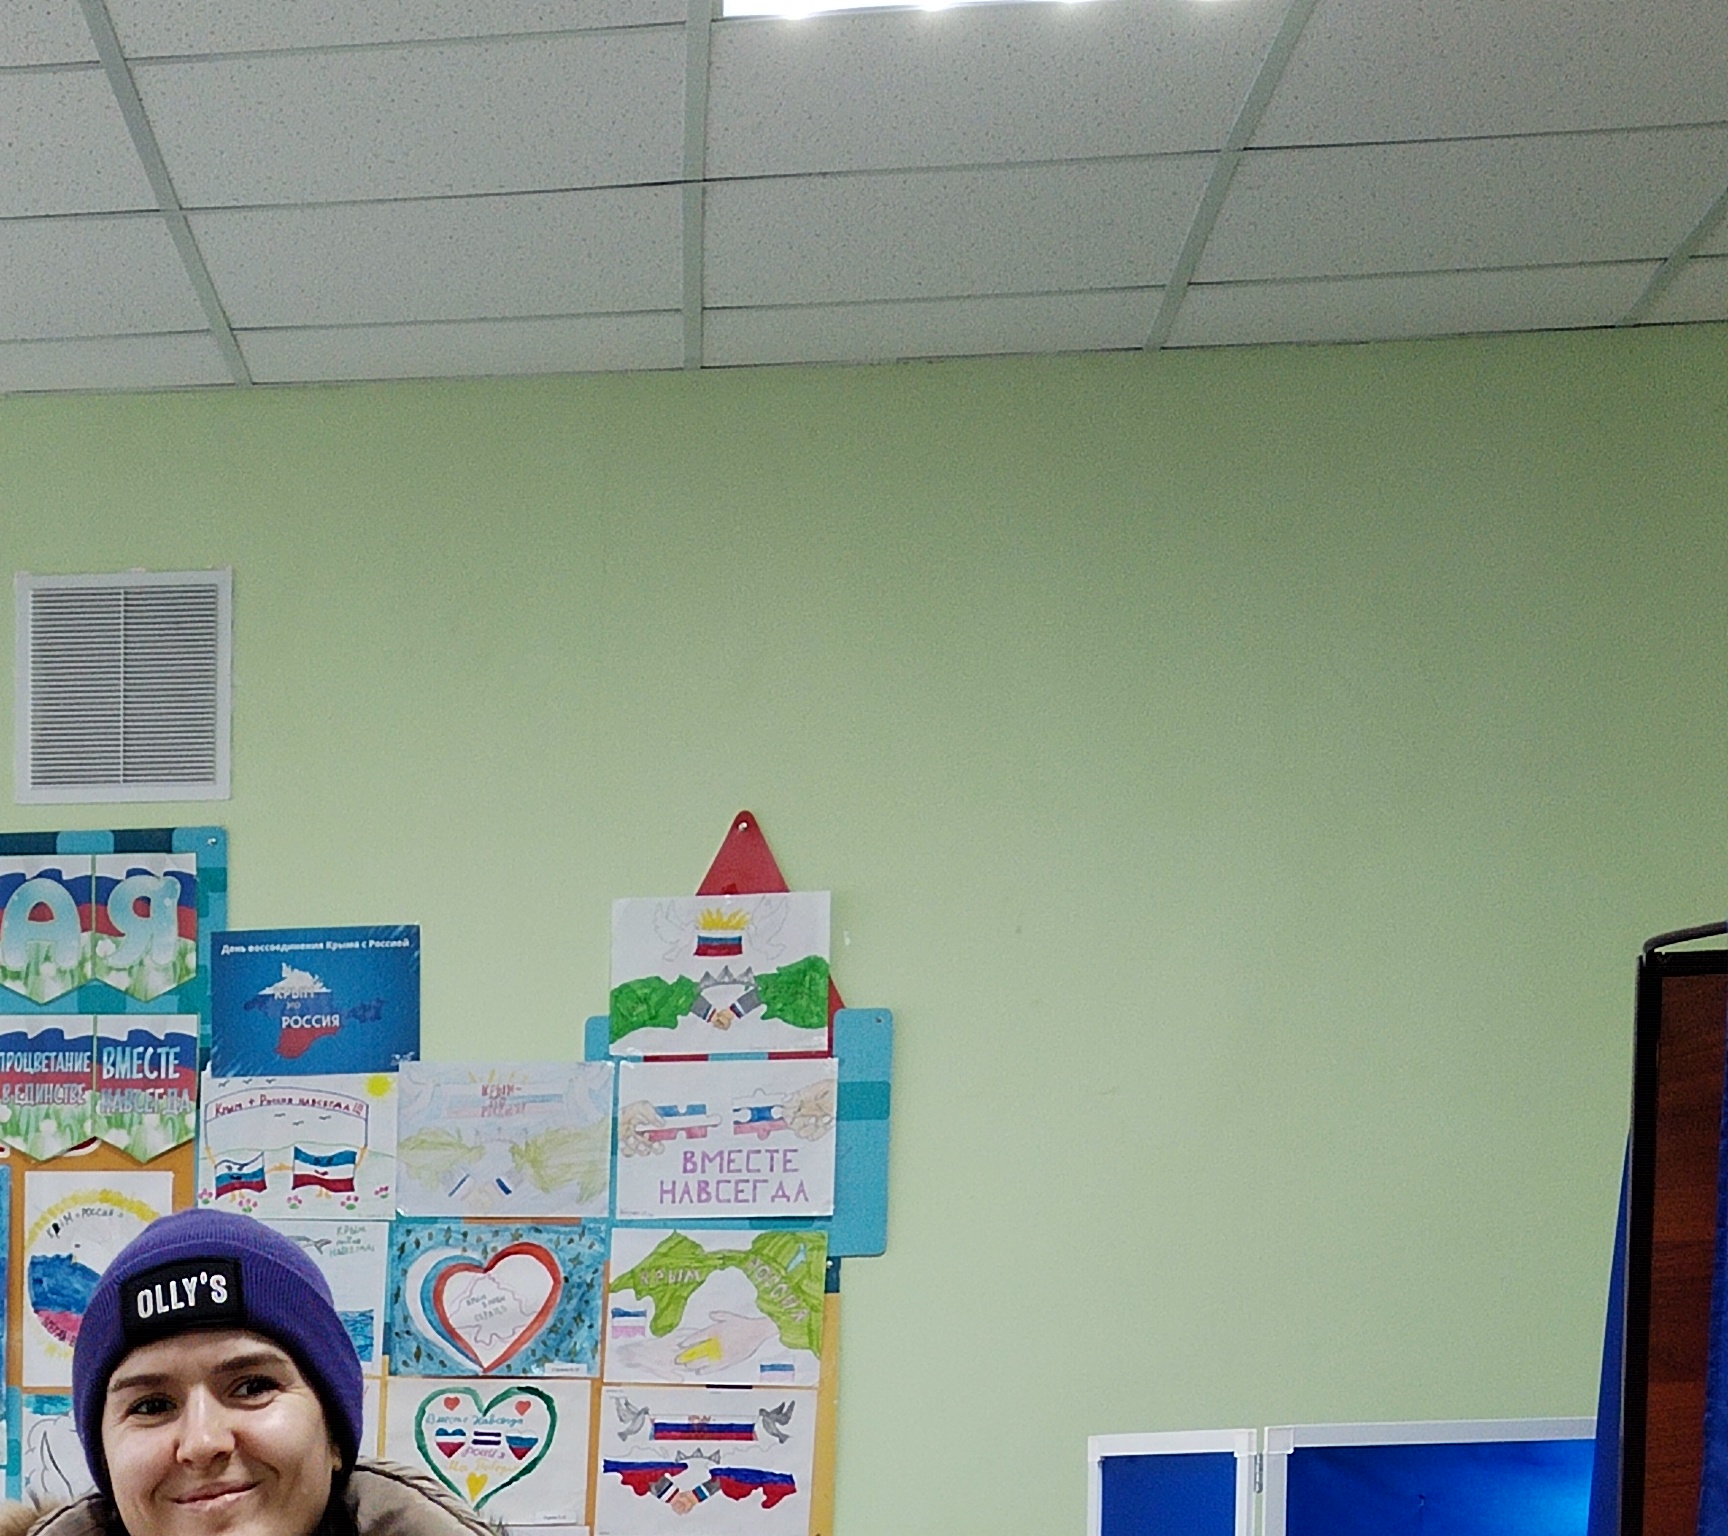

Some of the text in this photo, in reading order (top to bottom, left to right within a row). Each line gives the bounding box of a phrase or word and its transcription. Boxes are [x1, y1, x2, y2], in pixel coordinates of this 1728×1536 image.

[221, 943, 246, 955] День
[326, 940, 359, 951] Крыма
[368, 938, 409, 949] Россией
[281, 1013, 340, 1028] РОССИЯ
[102, 1046, 181, 1079] ВМЕСТЕ
[14, 1083, 87, 1106] ЕДИНСТВЕ
[99, 1088, 192, 1115] НАВСЕГДА
[682, 1148, 799, 1174] ВМЕСТЕ
[659, 1178, 810, 1204] НАВСЕГДА
[137, 1271, 228, 1319] OLLY'S
